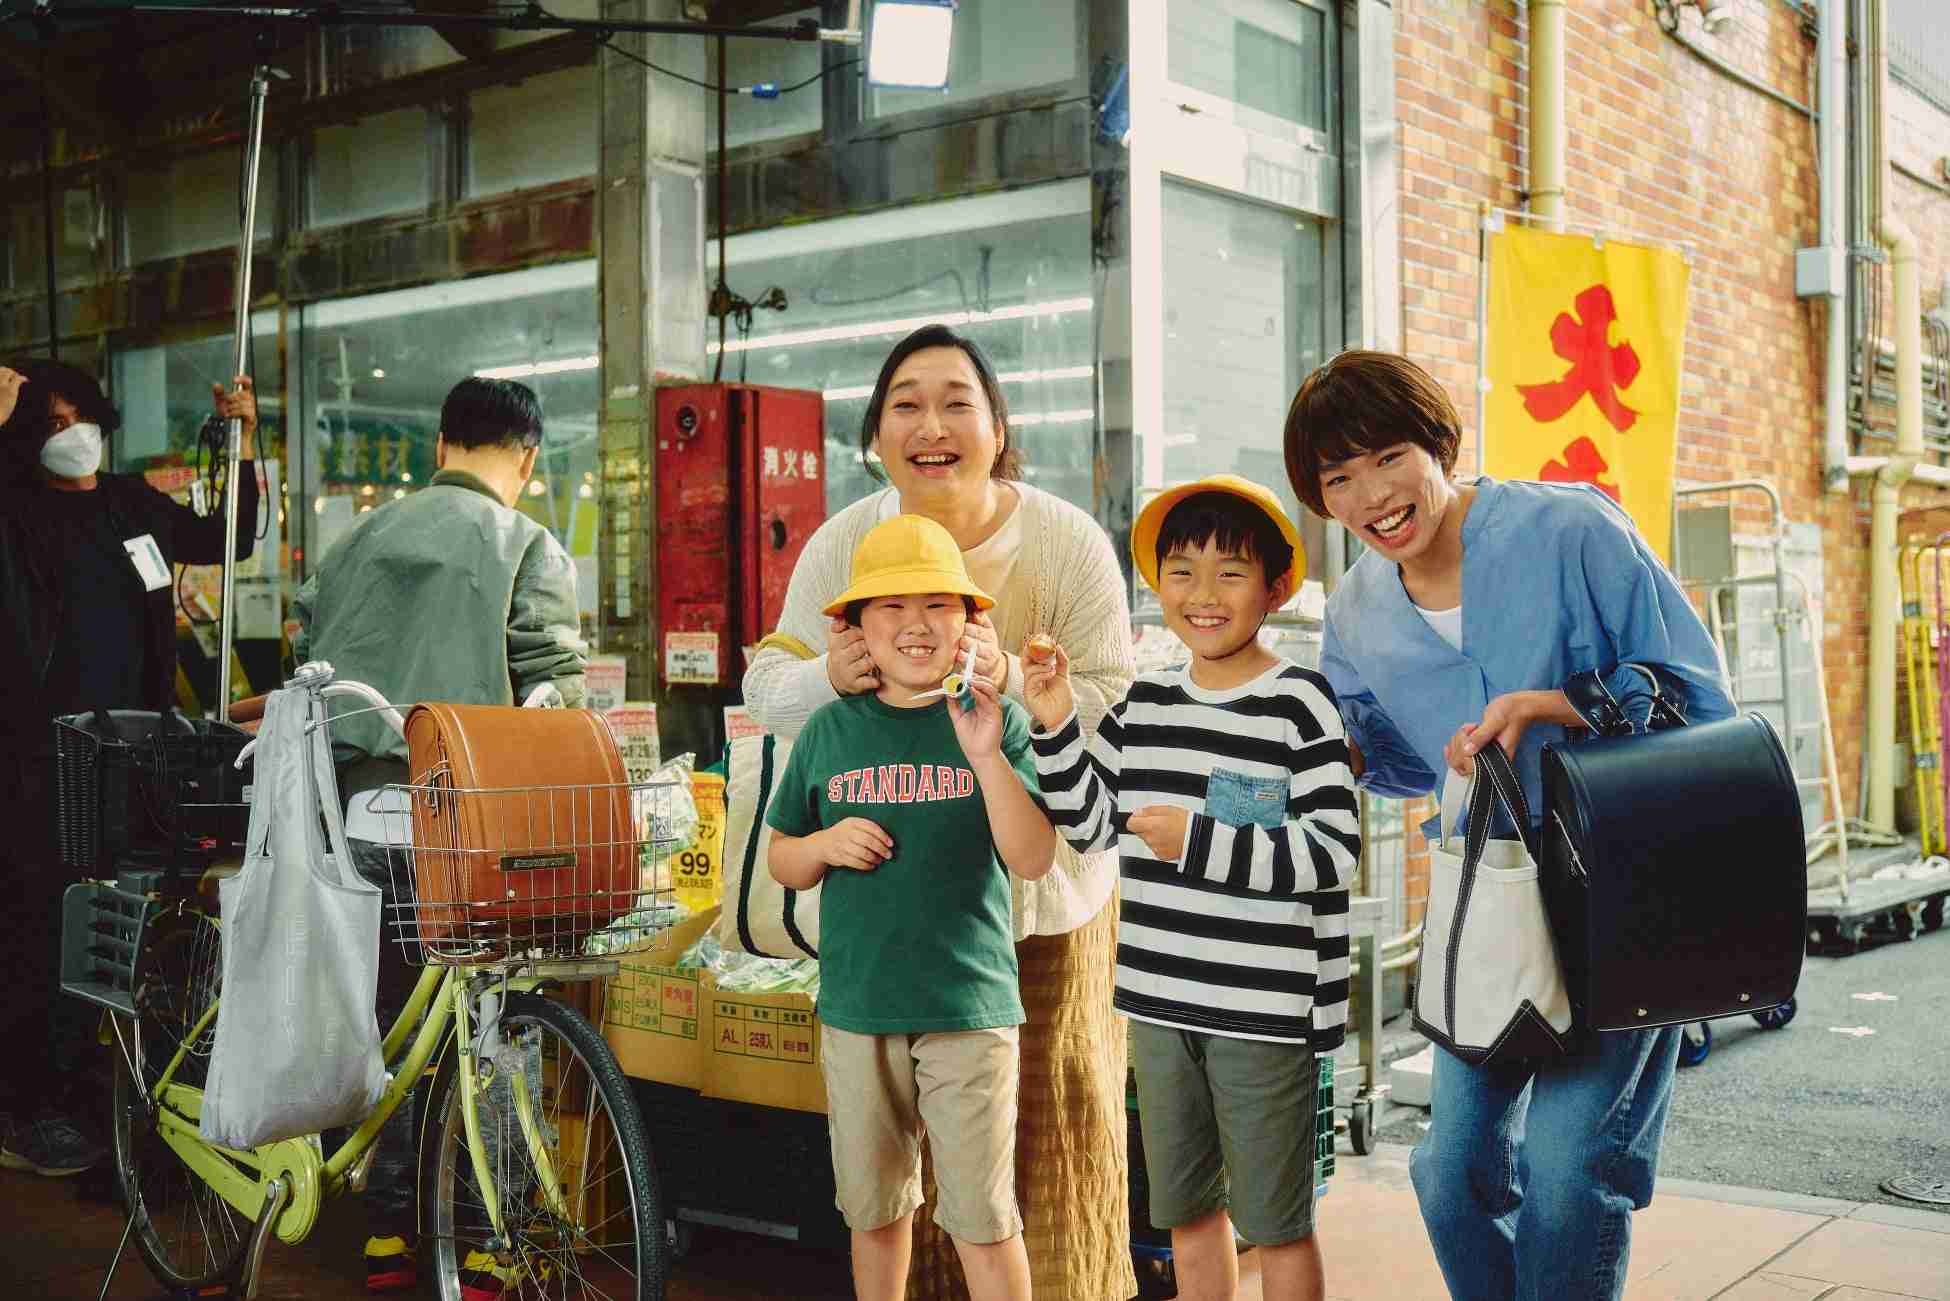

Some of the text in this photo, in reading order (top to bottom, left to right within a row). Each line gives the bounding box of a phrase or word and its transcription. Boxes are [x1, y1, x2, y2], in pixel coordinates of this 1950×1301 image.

[763, 447, 817, 480] 消火栓
[828, 764, 974, 803] STANDARD
[680, 851, 710, 877] 99
